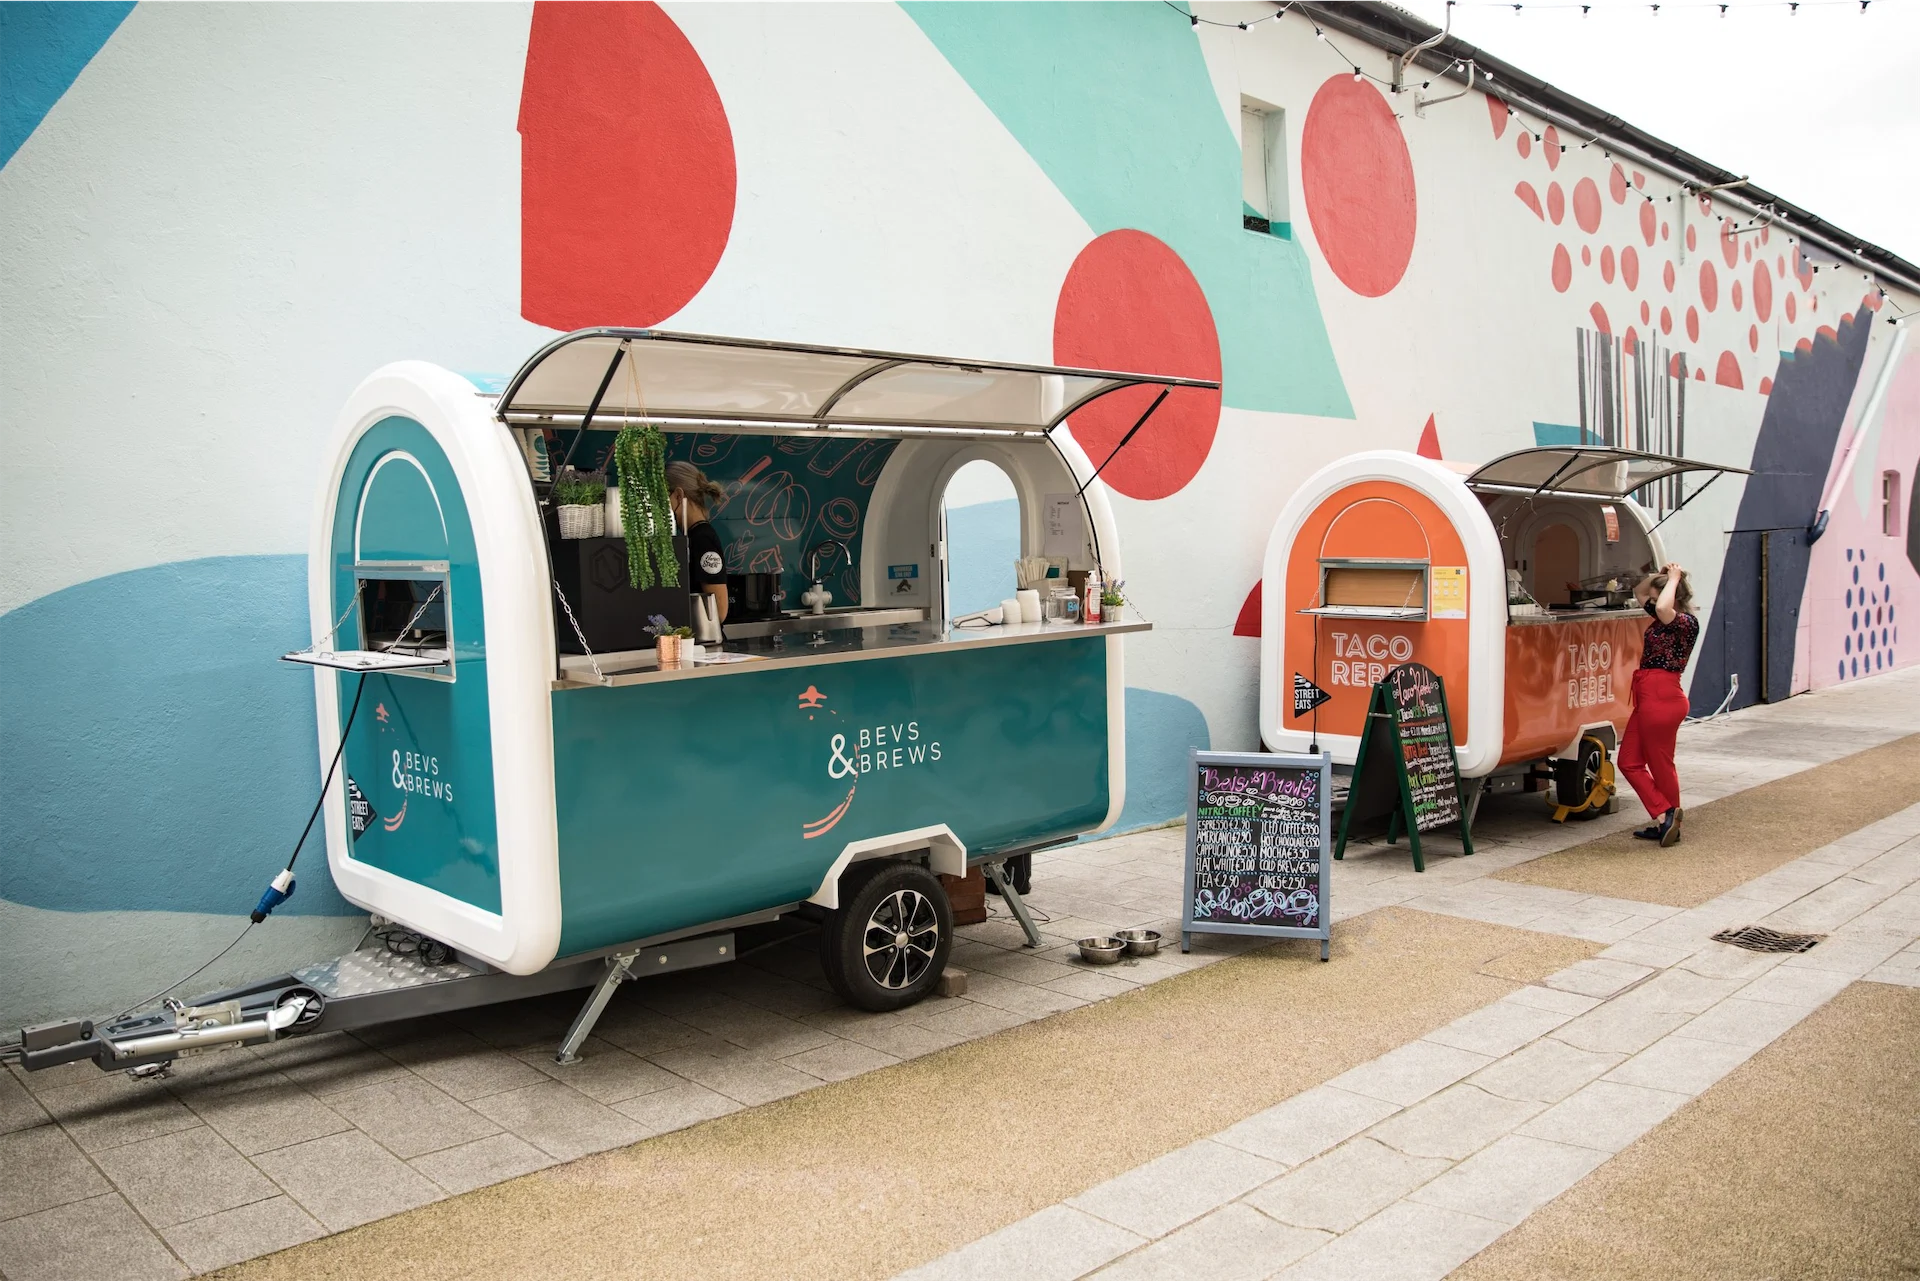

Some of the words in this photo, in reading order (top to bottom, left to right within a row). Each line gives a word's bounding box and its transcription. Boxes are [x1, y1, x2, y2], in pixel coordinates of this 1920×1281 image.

[1331, 632, 1413, 661] TACO
[1568, 641, 1612, 675] TACO
[1294, 688, 1320, 699] STREET
[1567, 674, 1615, 709] REBEL
[1294, 699, 1312, 710] EATS
[859, 721, 920, 749] BEVS
[406, 751, 439, 776] BEVS
[828, 733, 859, 779] &
[860, 742, 942, 773] BREWS
[392, 749, 408, 789] &
[407, 774, 453, 802] BREWS
[350, 800, 368, 816] STREET
[352, 815, 365, 831] EATS
[1197, 820, 1228, 830] ESPRESSO
[1261, 820, 1278, 835] ICED
[1280, 821, 1301, 835] COFFEE
[1197, 830, 1232, 845] AMERICANO
[1260, 834, 1274, 848] HOT
[1275, 835, 1306, 848] CHOCOLATE
[1196, 844, 1238, 858] CAPPUCCINO
[1260, 846, 1287, 859] MOCHA
[1196, 857, 1211, 871] FLAT
[1212, 857, 1236, 872] WHITE
[1259, 860, 1276, 871] COLD
[1277, 860, 1300, 874] BREW
[1196, 872, 1213, 888] TEA
[1258, 874, 1281, 890] CAKES
